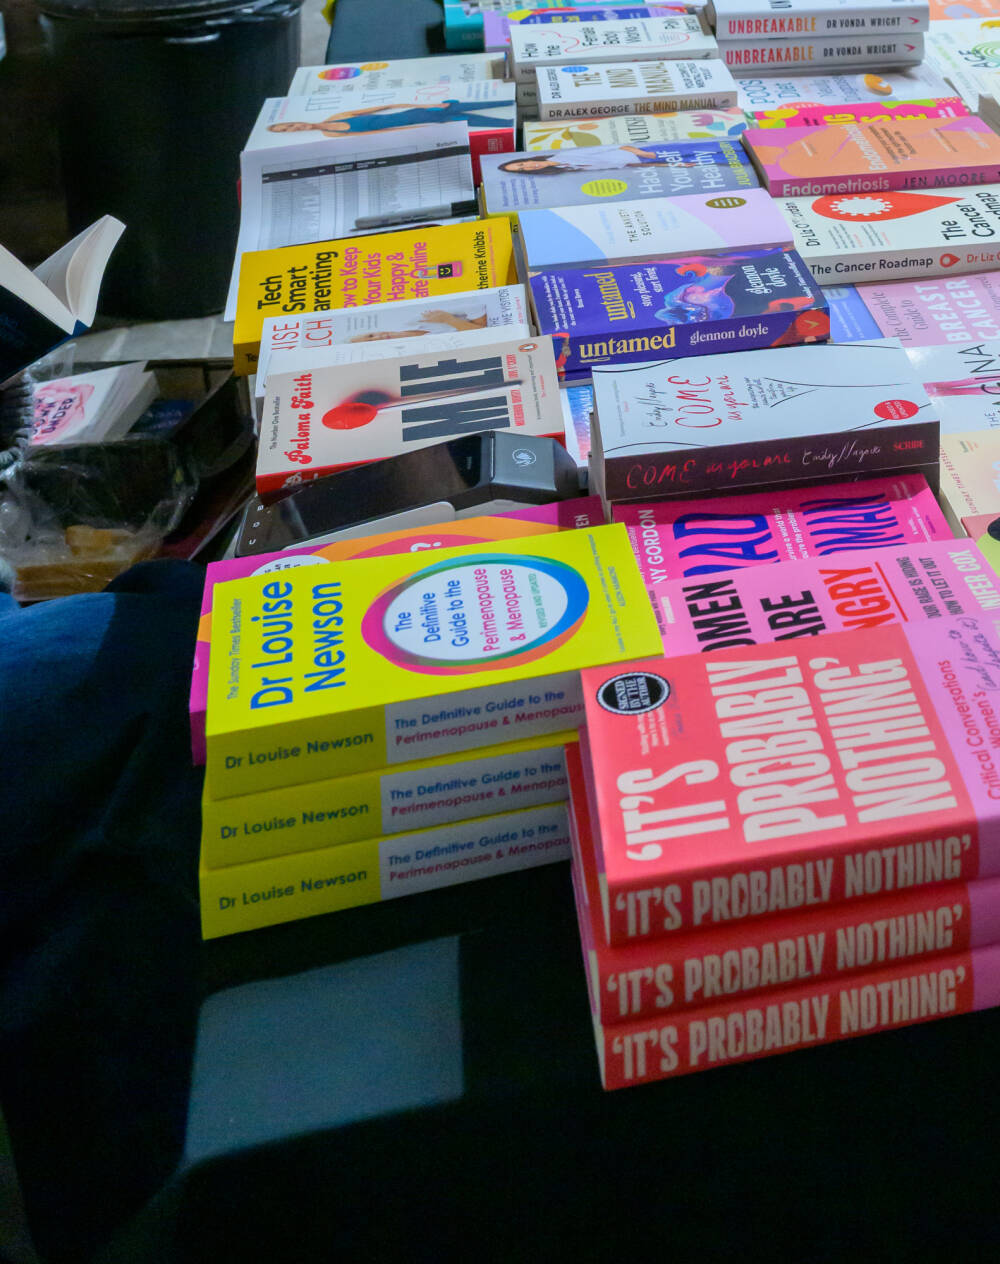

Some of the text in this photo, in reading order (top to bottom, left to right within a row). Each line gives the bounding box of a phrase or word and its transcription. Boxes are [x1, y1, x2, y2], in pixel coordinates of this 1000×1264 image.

[728, 16, 901, 34] UNBREAKABLE DR VONDA WRIGHT
[726, 44, 897, 65] UNBREAKABLE DR VONDA WRIGHT
[549, 97, 717, 118] DR ALEX GEORGE THE MIND MANUAL
[638, 167, 664, 195] Hack
[657, 150, 692, 191] Yourself
[694, 149, 723, 190] Healthy
[783, 173, 985, 196] Endometriosis JEN MOORE
[940, 219, 966, 240] The
[955, 203, 996, 238] Cancer
[473, 231, 485, 258] Knibbs
[811, 264, 832, 275] The
[835, 261, 876, 273] Cancer
[879, 256, 933, 271] Roadmap
[966, 254, 979, 263] Dr
[981, 252, 994, 262] Liz
[257, 275, 281, 309] Tech
[282, 265, 307, 311] Smart
[362, 252, 381, 305] Your Kids
[386, 252, 409, 300] Happy &
[584, 272, 627, 320] untamed
[741, 265, 771, 294] glennon
[760, 267, 786, 286] doyle
[914, 285, 973, 343] BREAST
[580, 323, 769, 354] untamed glennon doyle
[284, 373, 314, 464] Paloma Faith
[667, 375, 721, 428] COME
[984, 411, 1000, 427] THE
[638, 509, 665, 568] GORDON
[949, 550, 980, 571] COX
[394, 612, 411, 632] The
[420, 592, 440, 642] Definitive
[445, 580, 469, 646] Guide to the
[474, 568, 499, 651] Perimenopause
[500, 569, 526, 641] & Menopause
[226, 598, 241, 699] The Sunday Times Bestseller
[251, 582, 292, 708] Dr Louise
[304, 582, 344, 691] Newson
[394, 689, 565, 729] The Definitive Guide to the
[614, 680, 633, 709] SIGNED
[633, 676, 650, 706] AUTHOR
[938, 660, 983, 746] Conversations
[225, 731, 374, 770] Dr Louise Newson
[705, 656, 847, 843] PROBABLY
[808, 657, 958, 824] NOTHING’
[390, 761, 561, 801] The Definitive Guide to the
[220, 802, 369, 838] Dr Louise Newson
[219, 869, 368, 910] Dr Louise Newson
[693, 856, 834, 924] PROBABLY
[845, 834, 971, 896] NOTHING’
[684, 933, 826, 1002] PROBABLY
[836, 904, 963, 959] NOTHING’
